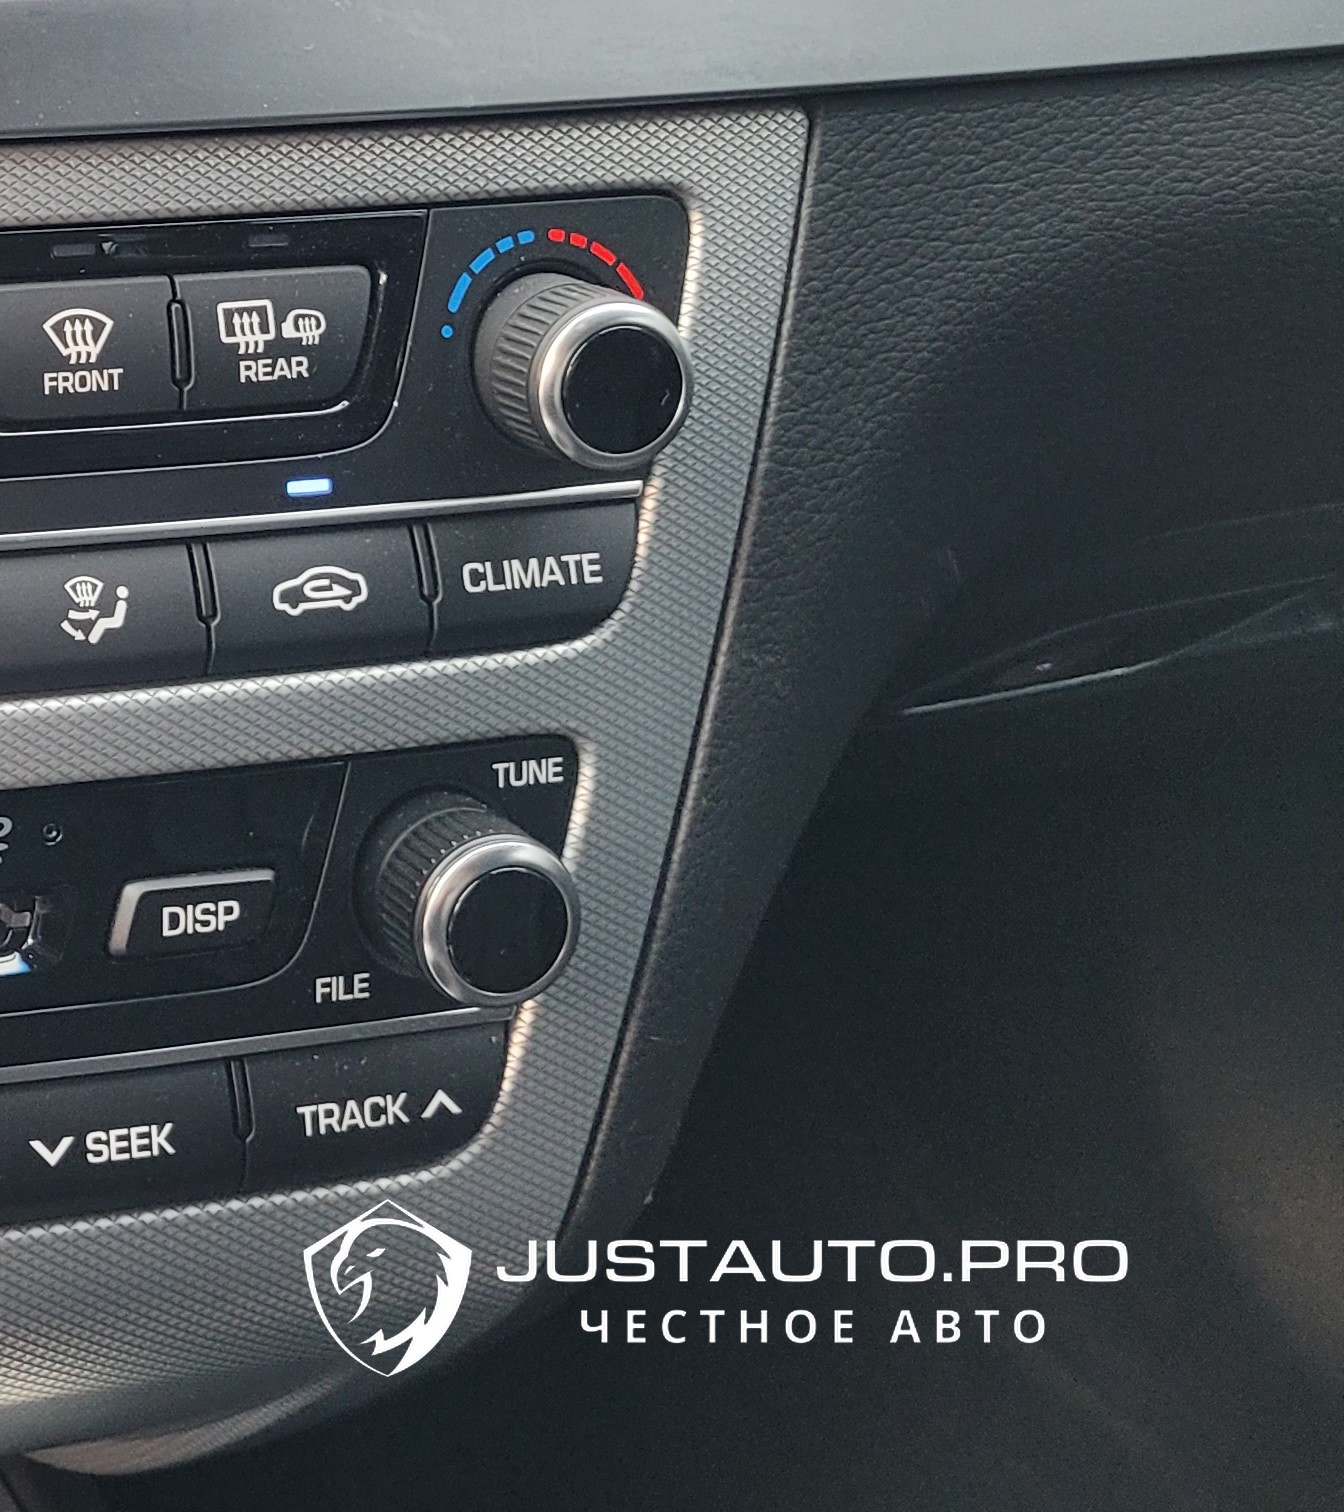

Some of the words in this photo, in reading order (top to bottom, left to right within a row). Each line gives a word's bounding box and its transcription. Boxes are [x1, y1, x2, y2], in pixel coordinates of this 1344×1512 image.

[43, 368, 124, 395] FRONT
[239, 355, 309, 383] REAR
[462, 552, 604, 593] CLIMATE
[491, 756, 564, 789] TUNE
[162, 900, 240, 937] DISP
[315, 972, 370, 1004] FILE
[296, 1092, 410, 1137] TRACK
[85, 1122, 176, 1164] SEEK
